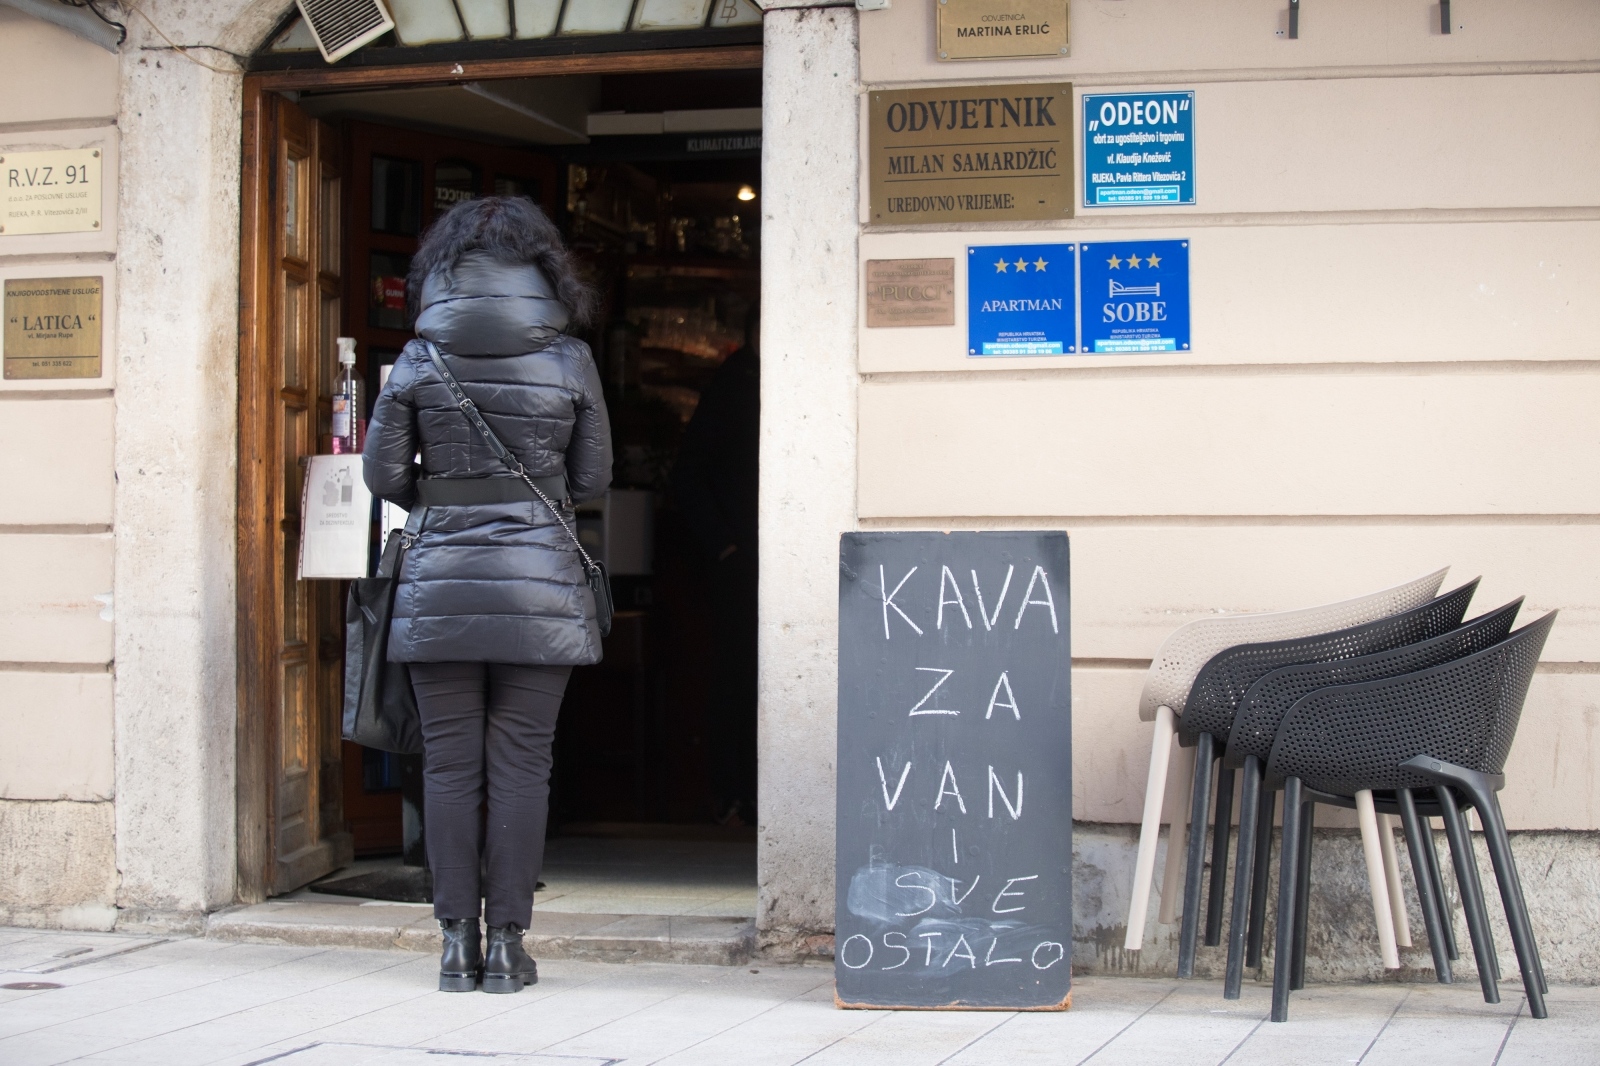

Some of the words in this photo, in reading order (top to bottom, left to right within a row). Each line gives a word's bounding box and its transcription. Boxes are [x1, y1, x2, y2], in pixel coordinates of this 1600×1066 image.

[981, 13, 1026, 23] ODVJETNICA
[957, 25, 1012, 38] MARTINA
[1015, 21, 1050, 36] ERLIĆ
[887, 96, 1056, 133] ODVJETNIK
[1093, 133, 1107, 145] obrt
[1107, 135, 1115, 144] za
[1115, 131, 1156, 146] ugostiteljstvo
[1160, 131, 1185, 145] trgovinu
[887, 153, 945, 175] MILAN
[952, 146, 1057, 173] SAMARDŽIĆ
[1116, 153, 1142, 167] Klaudija
[1142, 151, 1172, 163] Knežević
[8, 166, 59, 188] R.V.Z.
[65, 164, 89, 185] 91
[1092, 173, 1116, 185] RIJEKA,
[1116, 172, 1132, 183] Pavla
[1132, 171, 1152, 183] Rittera
[1152, 170, 1181, 182] Vitezovića
[1181, 170, 1186, 181] 2
[34, 193, 64, 201] POSLOVNE
[65, 191, 88, 199] USLUGE
[887, 196, 955, 213] UREDOVNO
[957, 193, 1015, 210] VRIJEME:
[44, 208, 74, 216] Vitezovića
[6, 288, 71, 297] KNJIGOVODSTVENE
[72, 287, 99, 295] USLUGE
[981, 299, 1062, 312] APARTMAN
[1103, 301, 1167, 323] SOBE
[23, 315, 82, 331] LATICA
[36, 332, 57, 340] Mirjana
[880, 564, 1059, 639] KAVA
[908, 667, 1021, 720] ZA
[876, 757, 1024, 820] VAN
[952, 829, 958, 863] I
[895, 871, 1039, 917] SVE
[841, 932, 1064, 971] OSTALO
